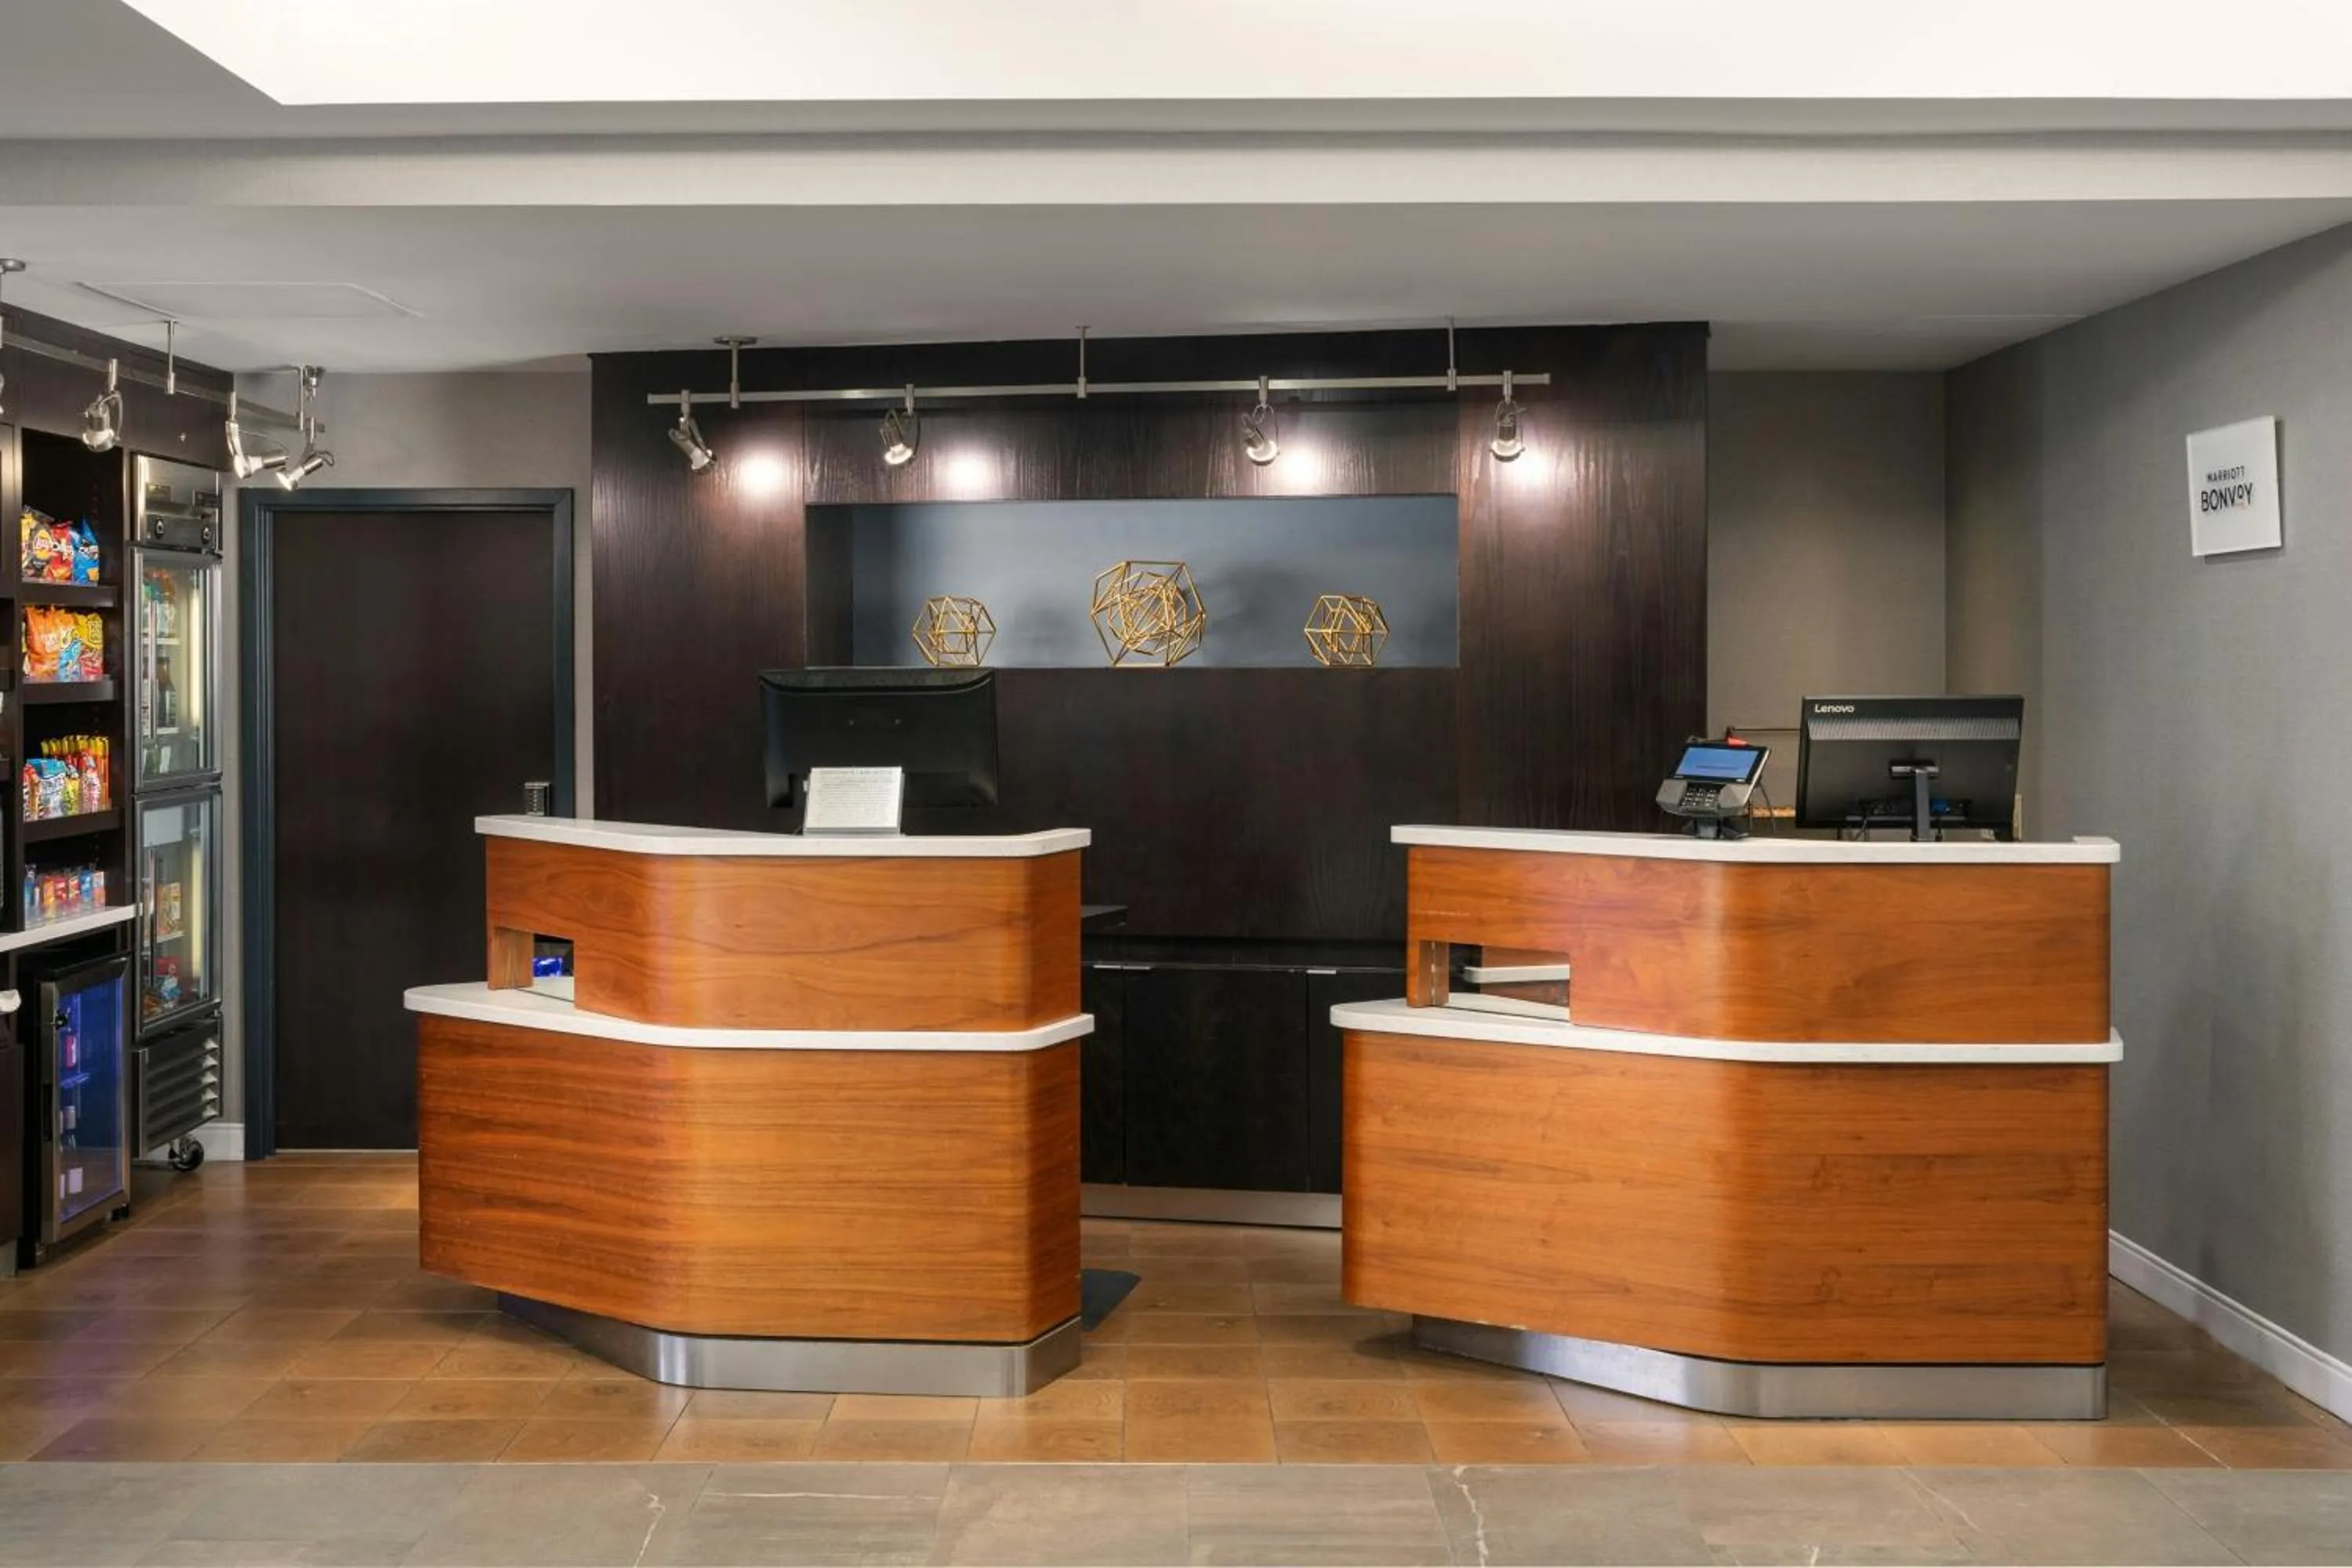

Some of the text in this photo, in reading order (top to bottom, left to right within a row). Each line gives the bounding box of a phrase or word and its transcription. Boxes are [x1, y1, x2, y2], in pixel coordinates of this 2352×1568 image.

[2207, 465, 2245, 483] MARRIOTT
[2201, 482, 2253, 512] BONVOY
[1814, 703, 1855, 713] Lenovo
